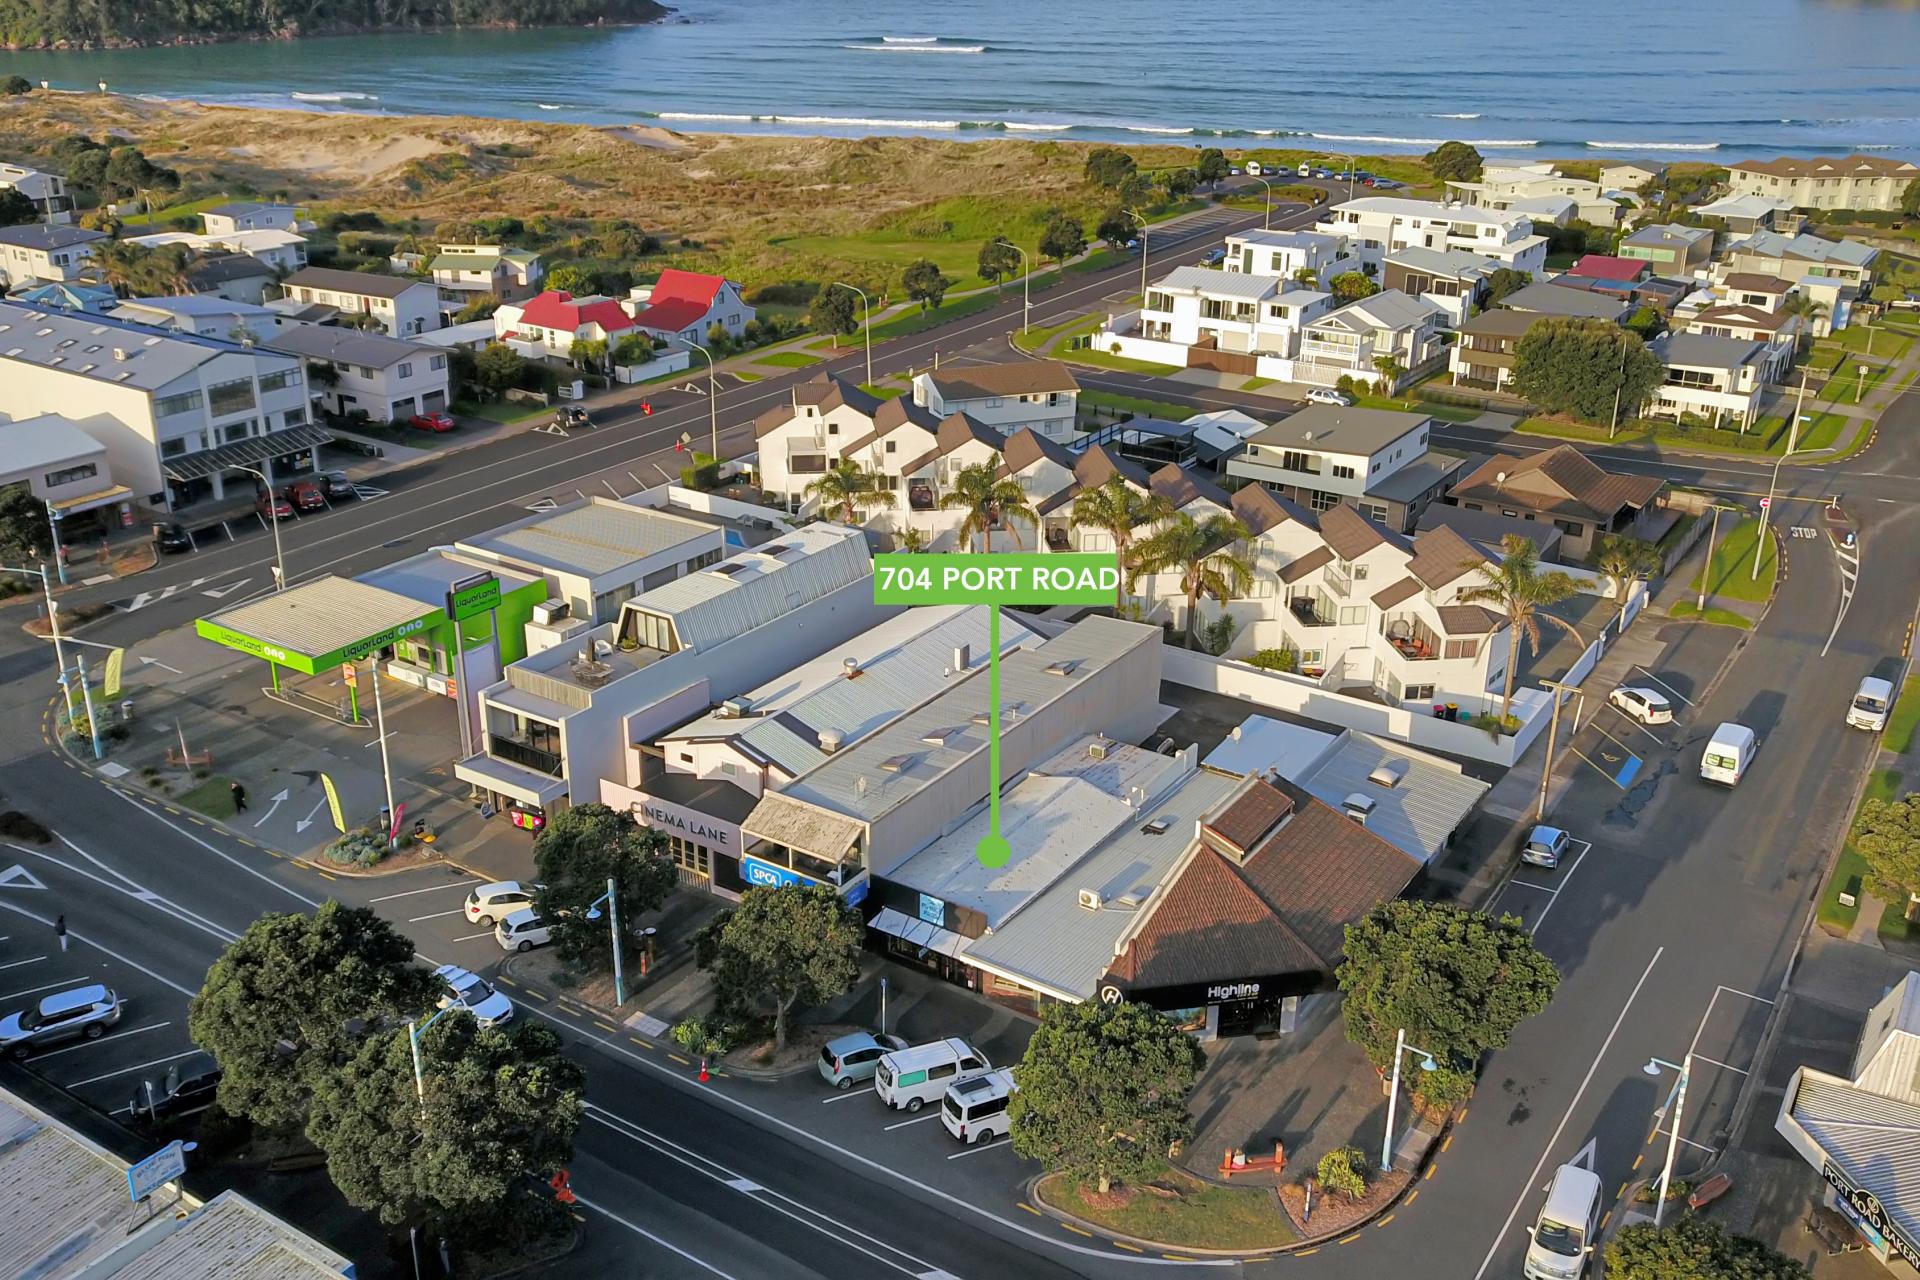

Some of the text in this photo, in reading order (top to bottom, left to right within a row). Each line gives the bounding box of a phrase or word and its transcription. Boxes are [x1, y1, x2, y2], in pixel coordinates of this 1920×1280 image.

[1791, 526, 1818, 539] STOP
[630, 801, 728, 845] CINEMA LANE
[753, 868, 778, 886] SPCA
[1207, 983, 1260, 999] Highline
[1825, 1167, 1851, 1197] PORT
[1851, 1194, 1881, 1228] ROAD
[1882, 1225, 1920, 1270] BAKERY
